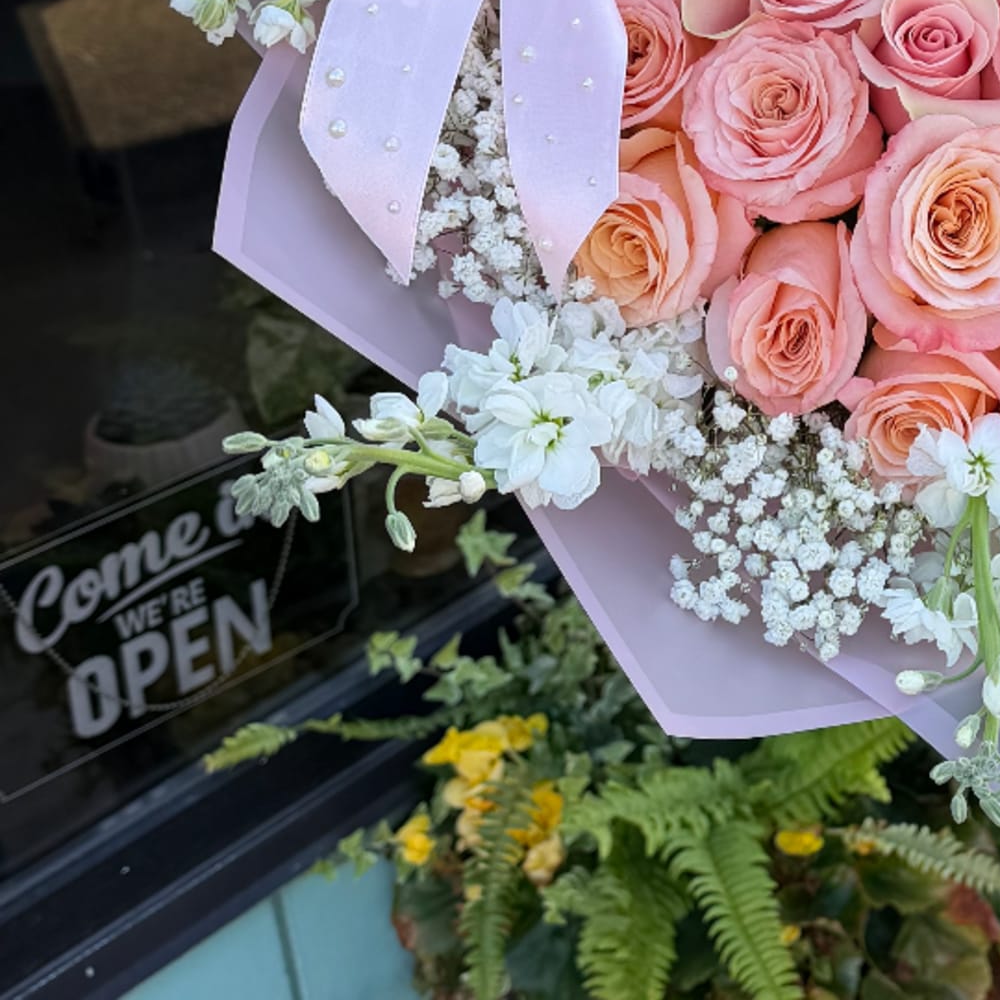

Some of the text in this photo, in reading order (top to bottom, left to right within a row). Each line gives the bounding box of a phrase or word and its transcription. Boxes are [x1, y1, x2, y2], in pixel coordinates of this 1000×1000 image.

[15, 511, 211, 654] Come
[112, 577, 207, 640] WE'RE
[67, 578, 273, 740] OPEN
